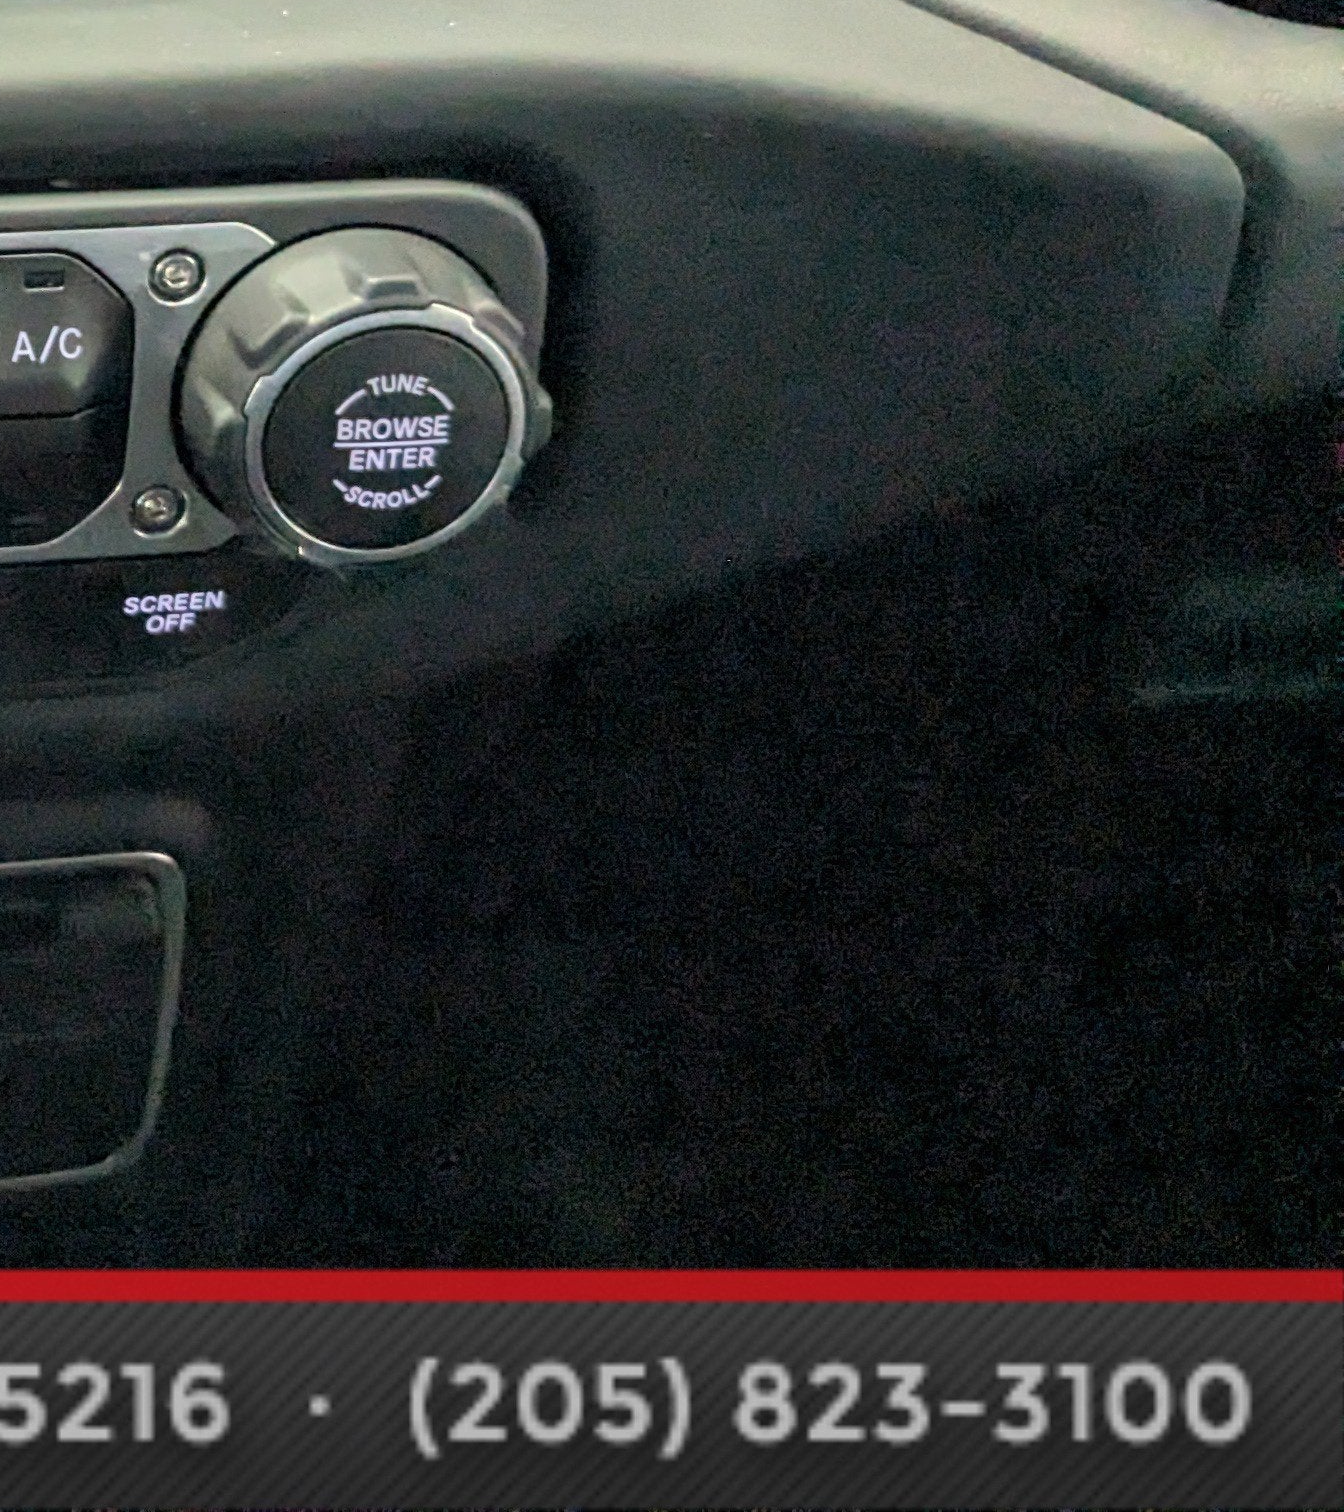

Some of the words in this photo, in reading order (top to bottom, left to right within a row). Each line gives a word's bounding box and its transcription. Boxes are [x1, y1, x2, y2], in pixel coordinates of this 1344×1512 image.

[11, 325, 84, 364] A/C
[366, 374, 429, 398] TUNE
[336, 414, 450, 441] BROWSE
[348, 447, 436, 472] ENTER
[343, 484, 430, 510] SCROLL
[123, 590, 225, 617] SCREEN
[145, 614, 197, 635] OFF
